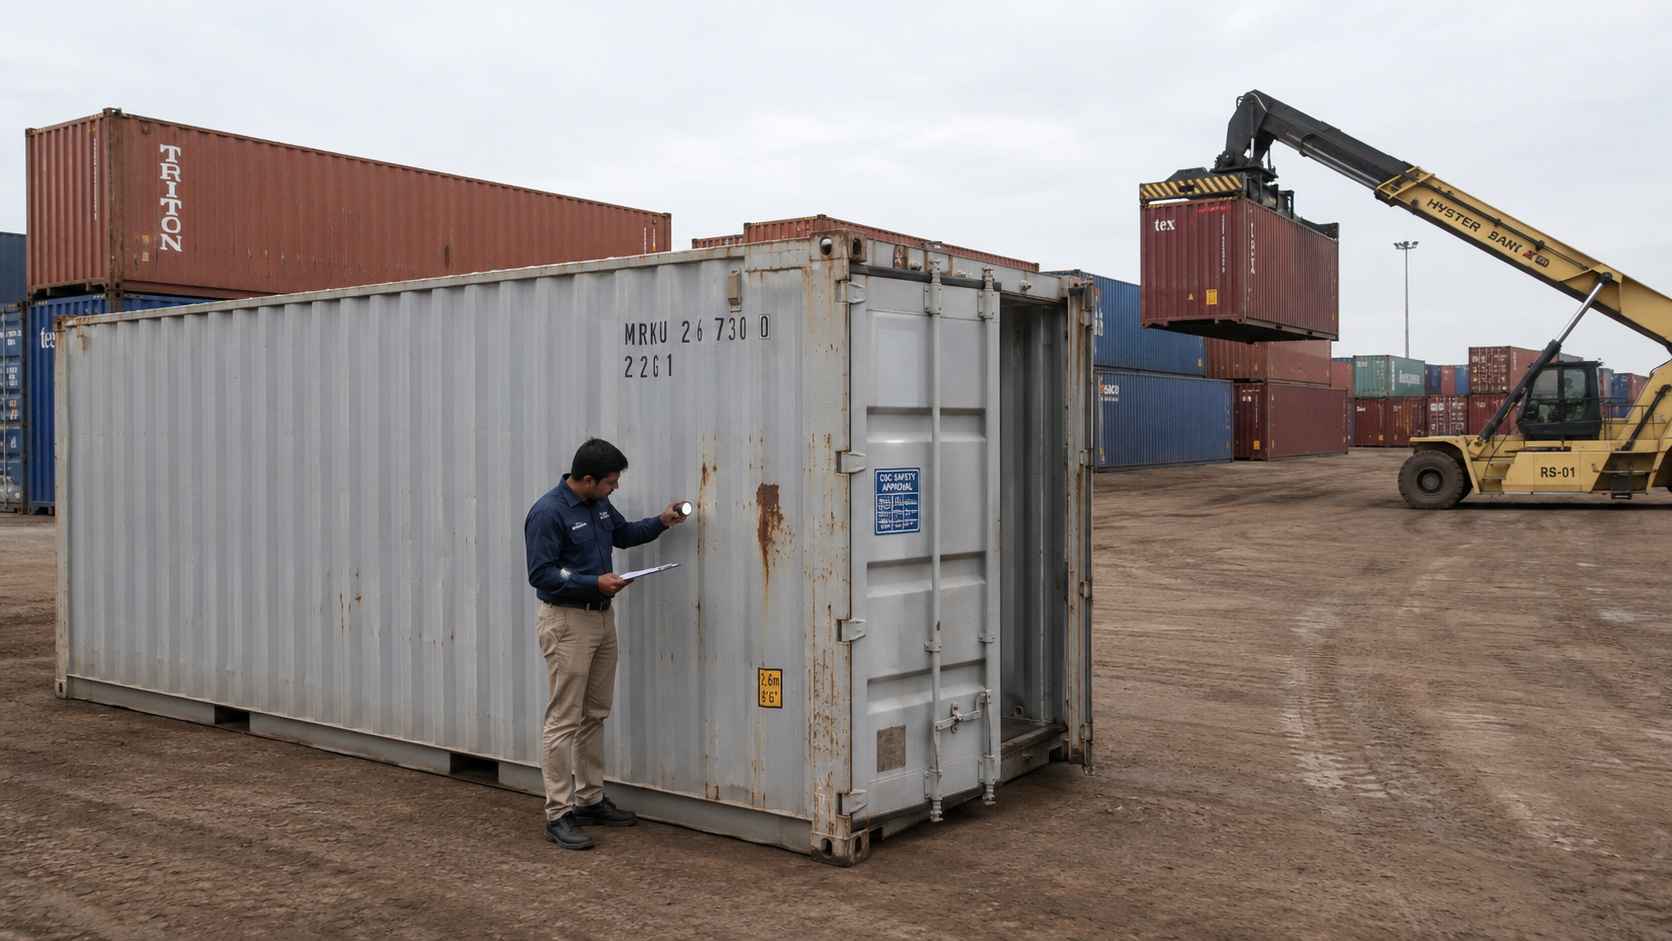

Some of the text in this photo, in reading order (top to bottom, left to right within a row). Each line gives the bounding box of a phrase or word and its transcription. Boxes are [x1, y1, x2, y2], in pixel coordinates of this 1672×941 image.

[160, 144, 183, 252] TRITON
[1154, 219, 1175, 232] tex
[1427, 199, 1481, 232] HYSTER
[625, 321, 667, 346] MRKU
[681, 320, 703, 343] 26
[715, 317, 746, 341] 730
[624, 353, 672, 378] 22G1
[1540, 466, 1575, 478] RS-01
